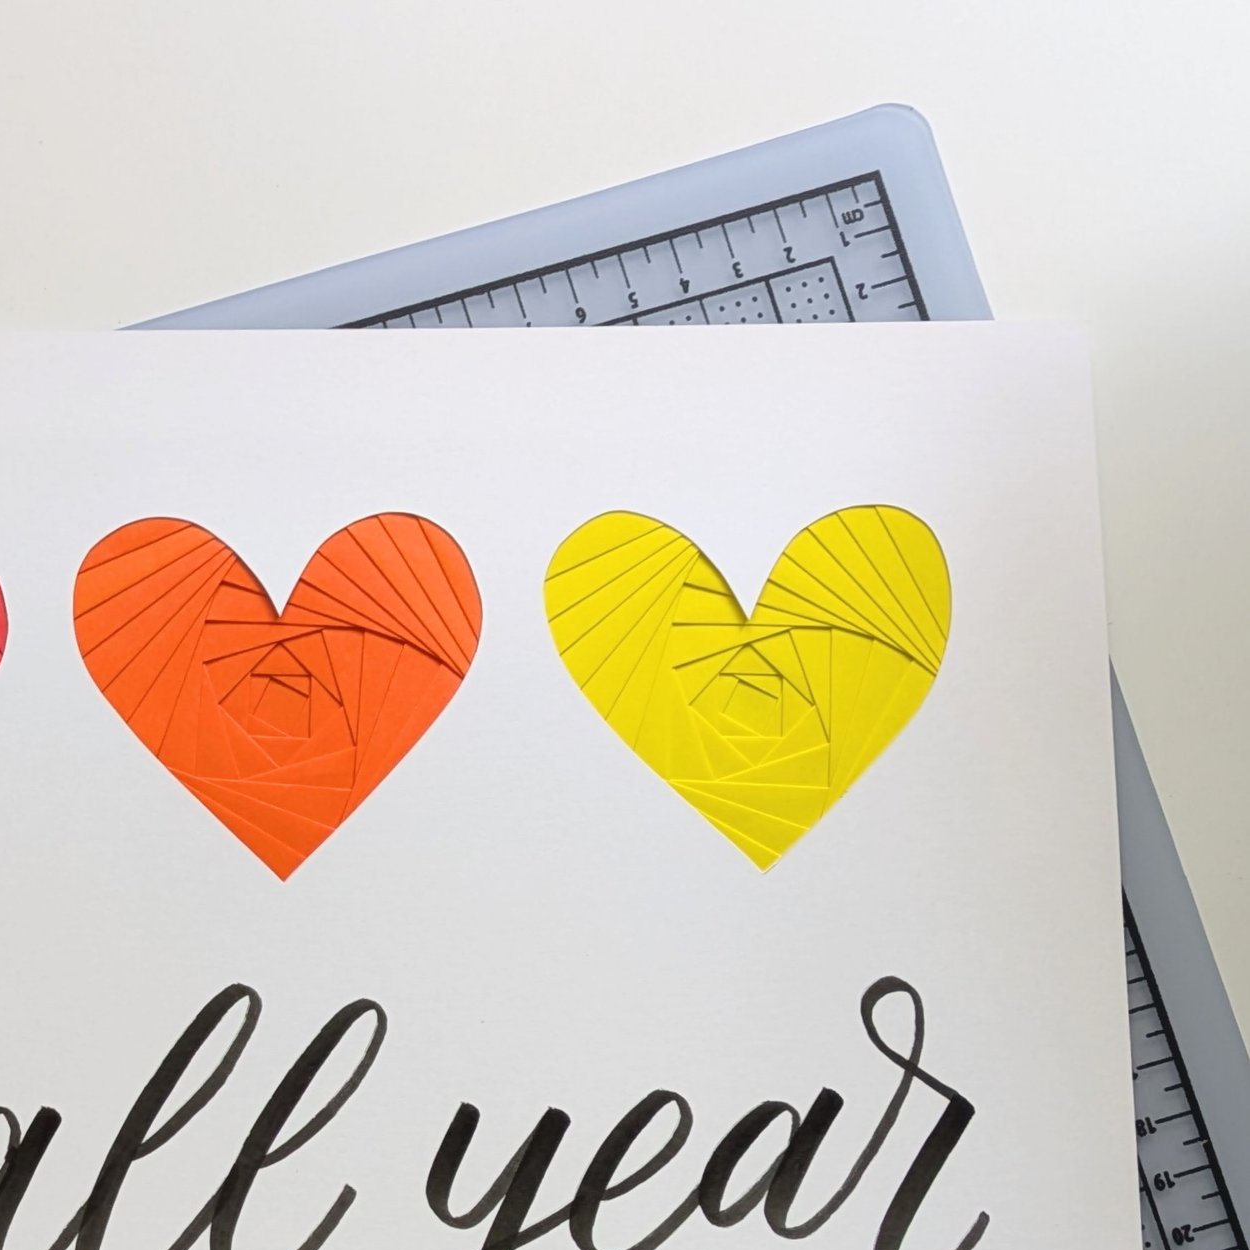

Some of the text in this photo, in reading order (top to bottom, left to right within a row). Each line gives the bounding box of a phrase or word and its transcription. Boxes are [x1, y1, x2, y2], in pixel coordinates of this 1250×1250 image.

[842, 209, 864, 225] cm
[840, 232, 850, 247] 1
[783, 247, 795, 263] 2
[733, 262, 743, 278] 3
[680, 278, 689, 293] 4
[856, 283, 868, 300] 2
[628, 292, 638, 309] 5
[575, 307, 586, 323] 6
[1136, 1117, 1156, 1138] 18
[1154, 1171, 1175, 1191] 19
[1172, 1225, 1194, 1246] 20
